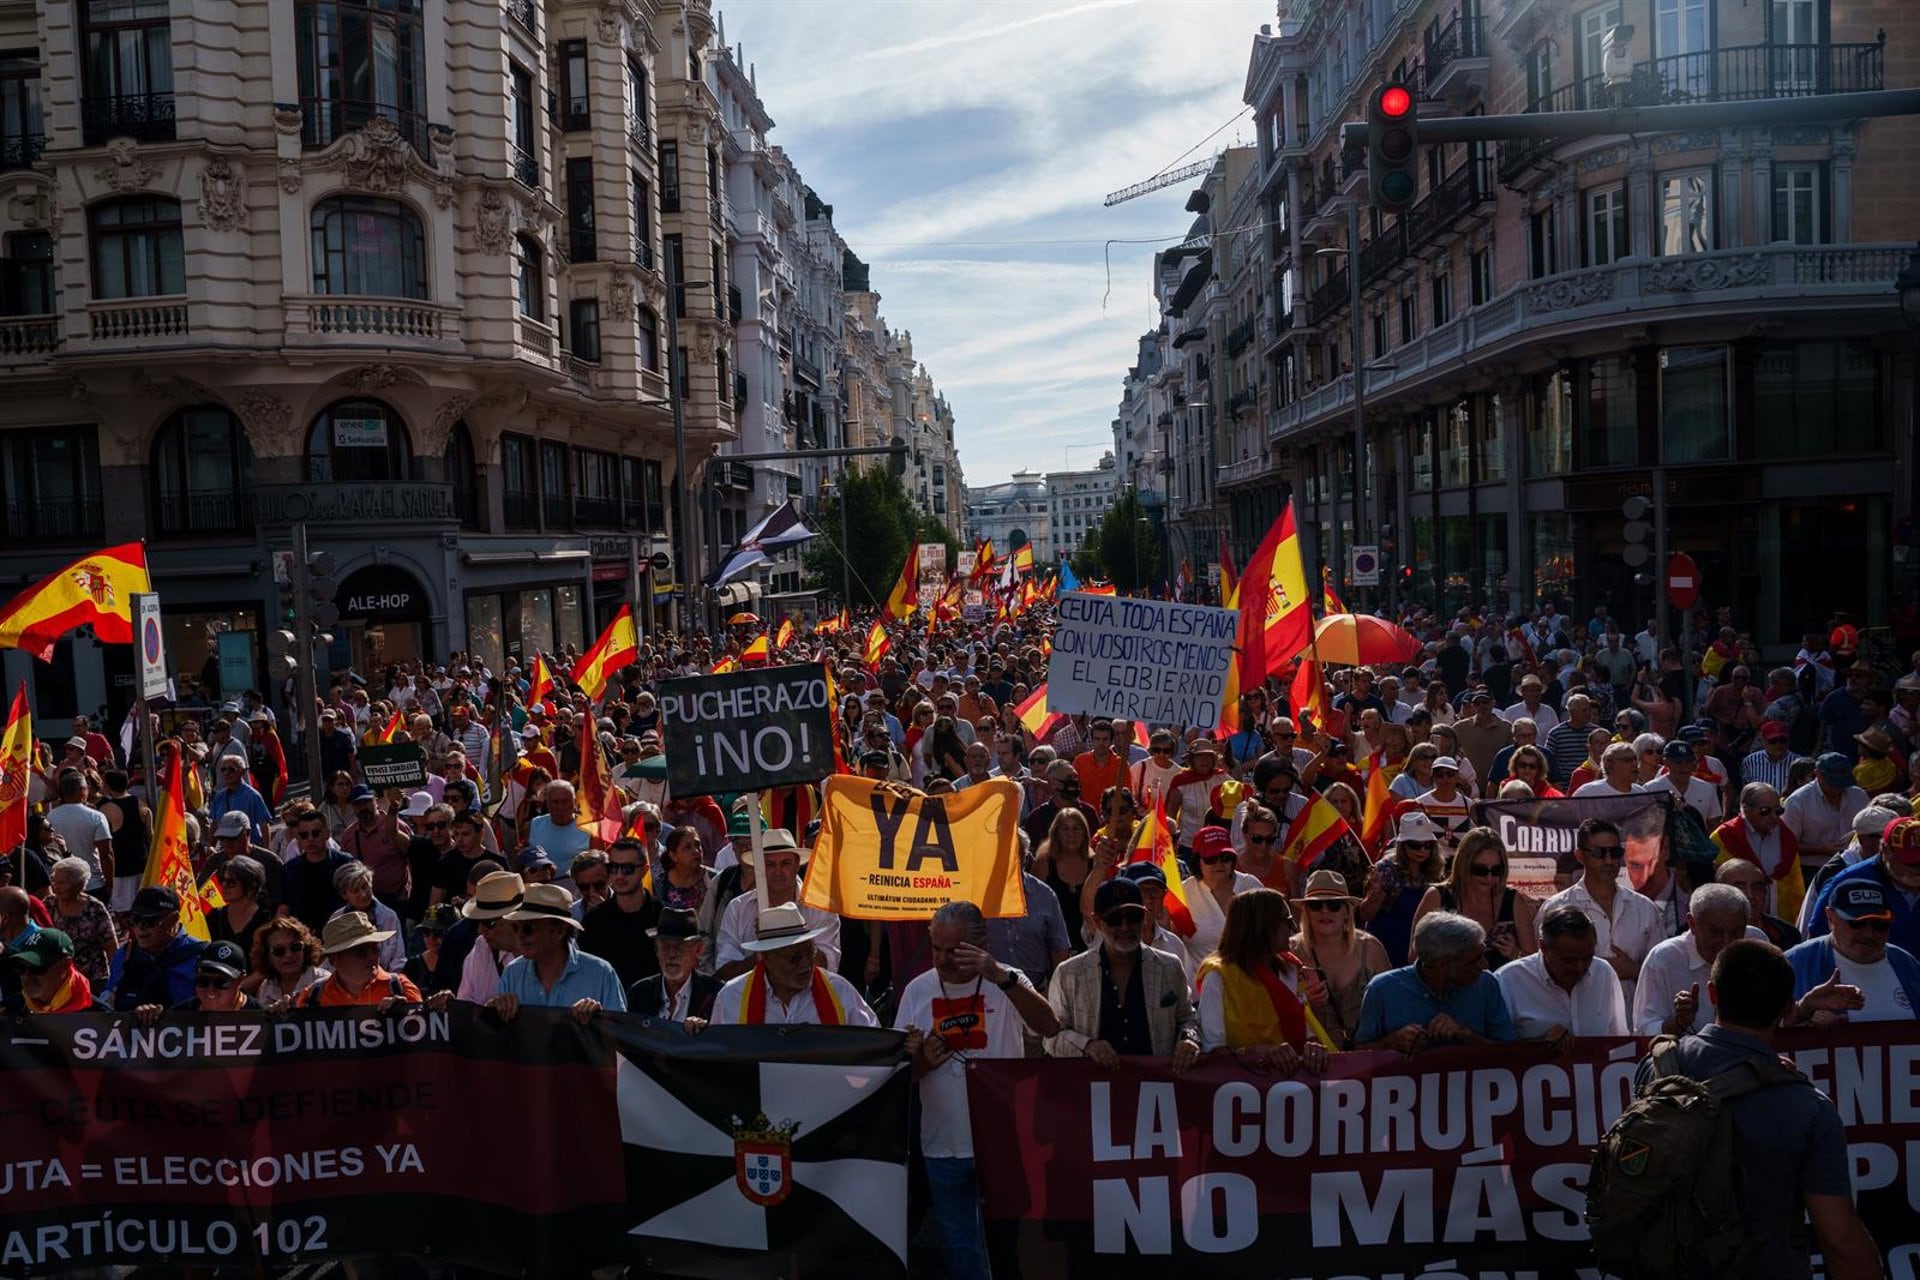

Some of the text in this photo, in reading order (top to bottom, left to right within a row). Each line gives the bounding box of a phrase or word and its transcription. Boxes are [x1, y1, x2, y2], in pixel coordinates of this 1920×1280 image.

[348, 594, 410, 611] ALE-HOP
[1121, 601, 1164, 632] TODA
[1169, 608, 1236, 640] ESPAÑA
[1073, 660, 1221, 697] EL GOBIERNO
[1174, 641, 1229, 672] MENOS
[660, 679, 828, 726] PUCHERAZO
[1094, 687, 1215, 729] MARCIANO
[870, 793, 959, 872] YA
[868, 874, 951, 889] REINICIA ESPAÑA
[72, 1020, 262, 1060] SÁNCHEZ
[274, 1010, 451, 1054] DIMISIÓN
[174, 1097, 222, 1128] SE
[236, 1081, 438, 1122] DEFIENDE
[1089, 1042, 1635, 1162] LA CORRUPCIÓ
[115, 1146, 365, 1187] ELECCIONES
[375, 1143, 425, 1174] YA
[1092, 1142, 1594, 1257] NO MÁS
[2, 1210, 329, 1266] ARTÍCULO 102
